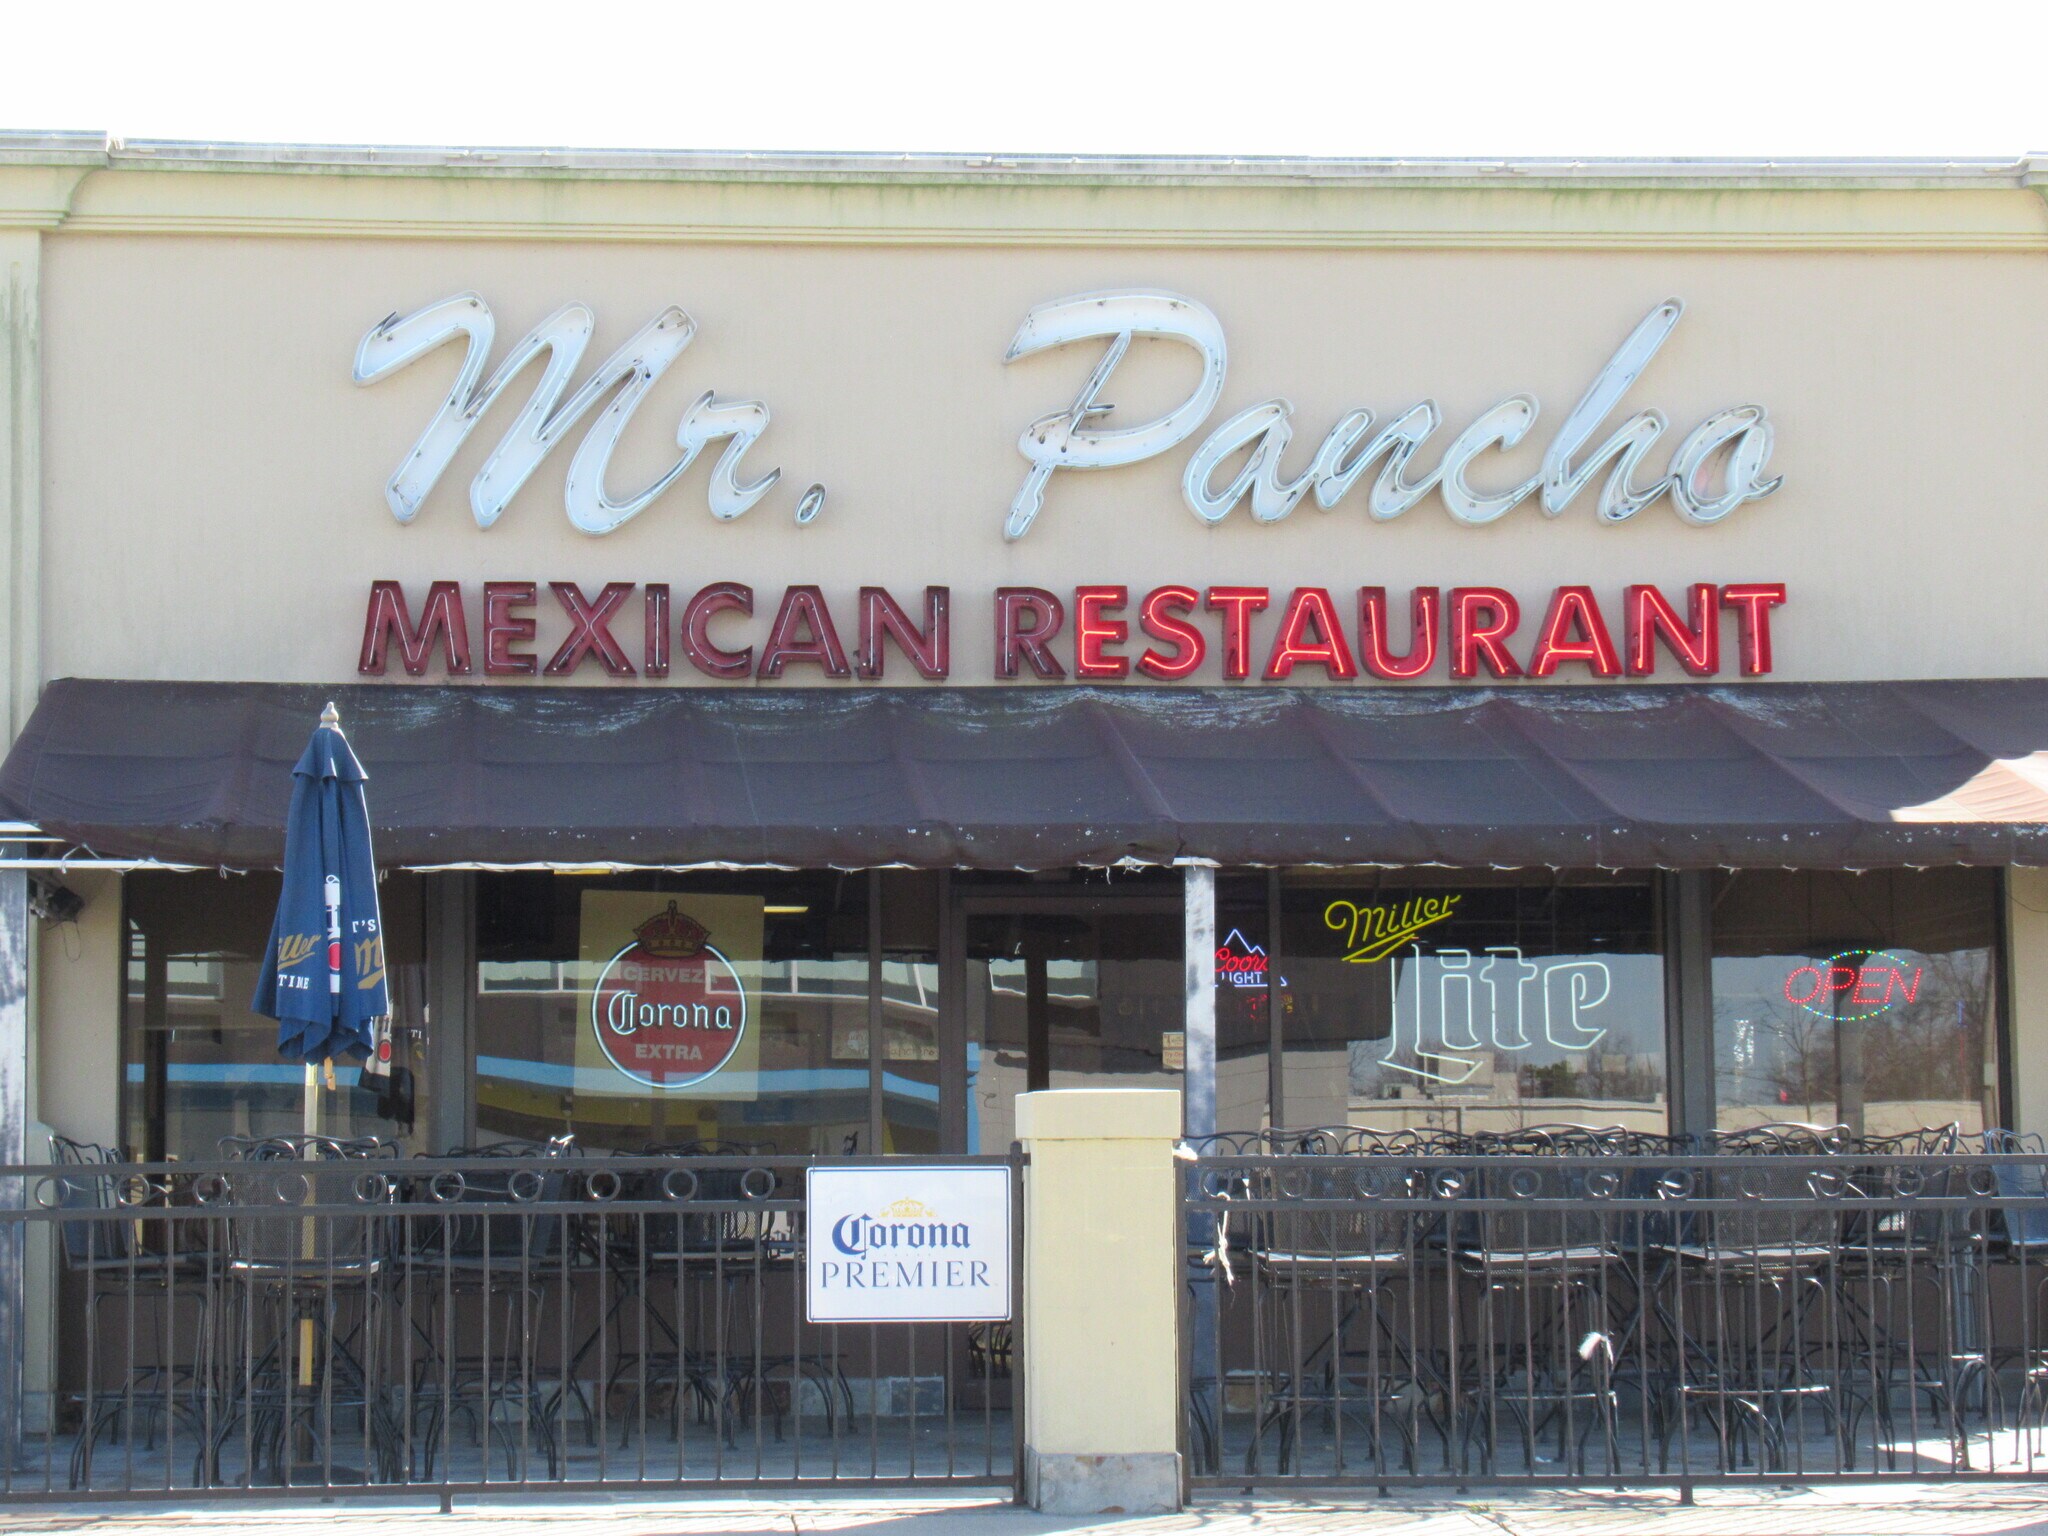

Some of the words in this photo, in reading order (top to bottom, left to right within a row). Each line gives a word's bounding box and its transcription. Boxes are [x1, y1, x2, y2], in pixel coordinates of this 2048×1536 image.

[352, 289, 827, 538] Mr.
[1003, 288, 1783, 542] Pancho
[358, 580, 951, 680] MEXICAN
[994, 583, 1787, 681] RESTAURANT
[352, 919, 376, 933] T'S
[1325, 895, 1461, 948] Miller
[278, 933, 321, 961] ller
[1784, 966, 1923, 1004] OPEN
[608, 990, 732, 1035] Corona
[1377, 944, 1611, 1084] Lite
[635, 1043, 703, 1060] EXTRA
[832, 1213, 971, 1260] Corona
[821, 1260, 990, 1288] PREMIER
